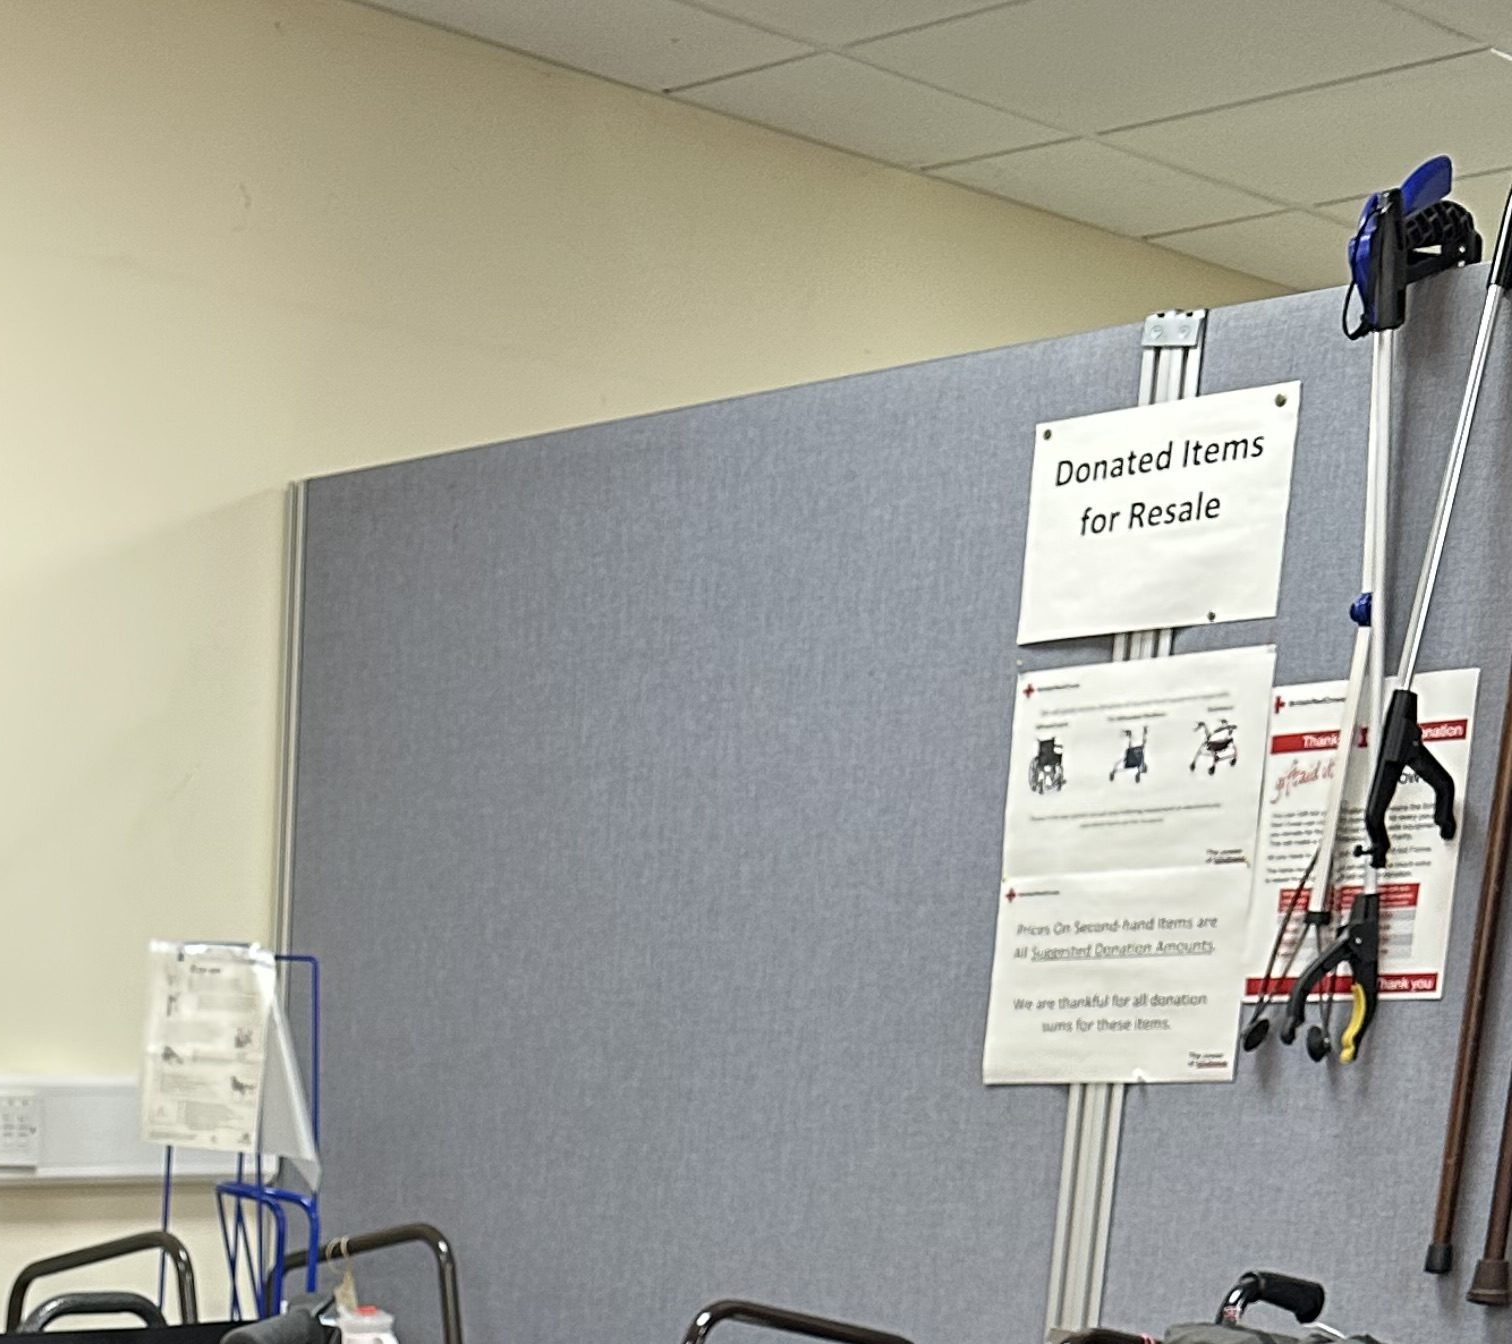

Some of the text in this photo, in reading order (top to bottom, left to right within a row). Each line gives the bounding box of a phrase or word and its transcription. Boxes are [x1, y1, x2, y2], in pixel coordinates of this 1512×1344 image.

[1055, 432, 1265, 487] Donated Items
[1080, 491, 1222, 537] for Resale
[1410, 979, 1433, 993] you
